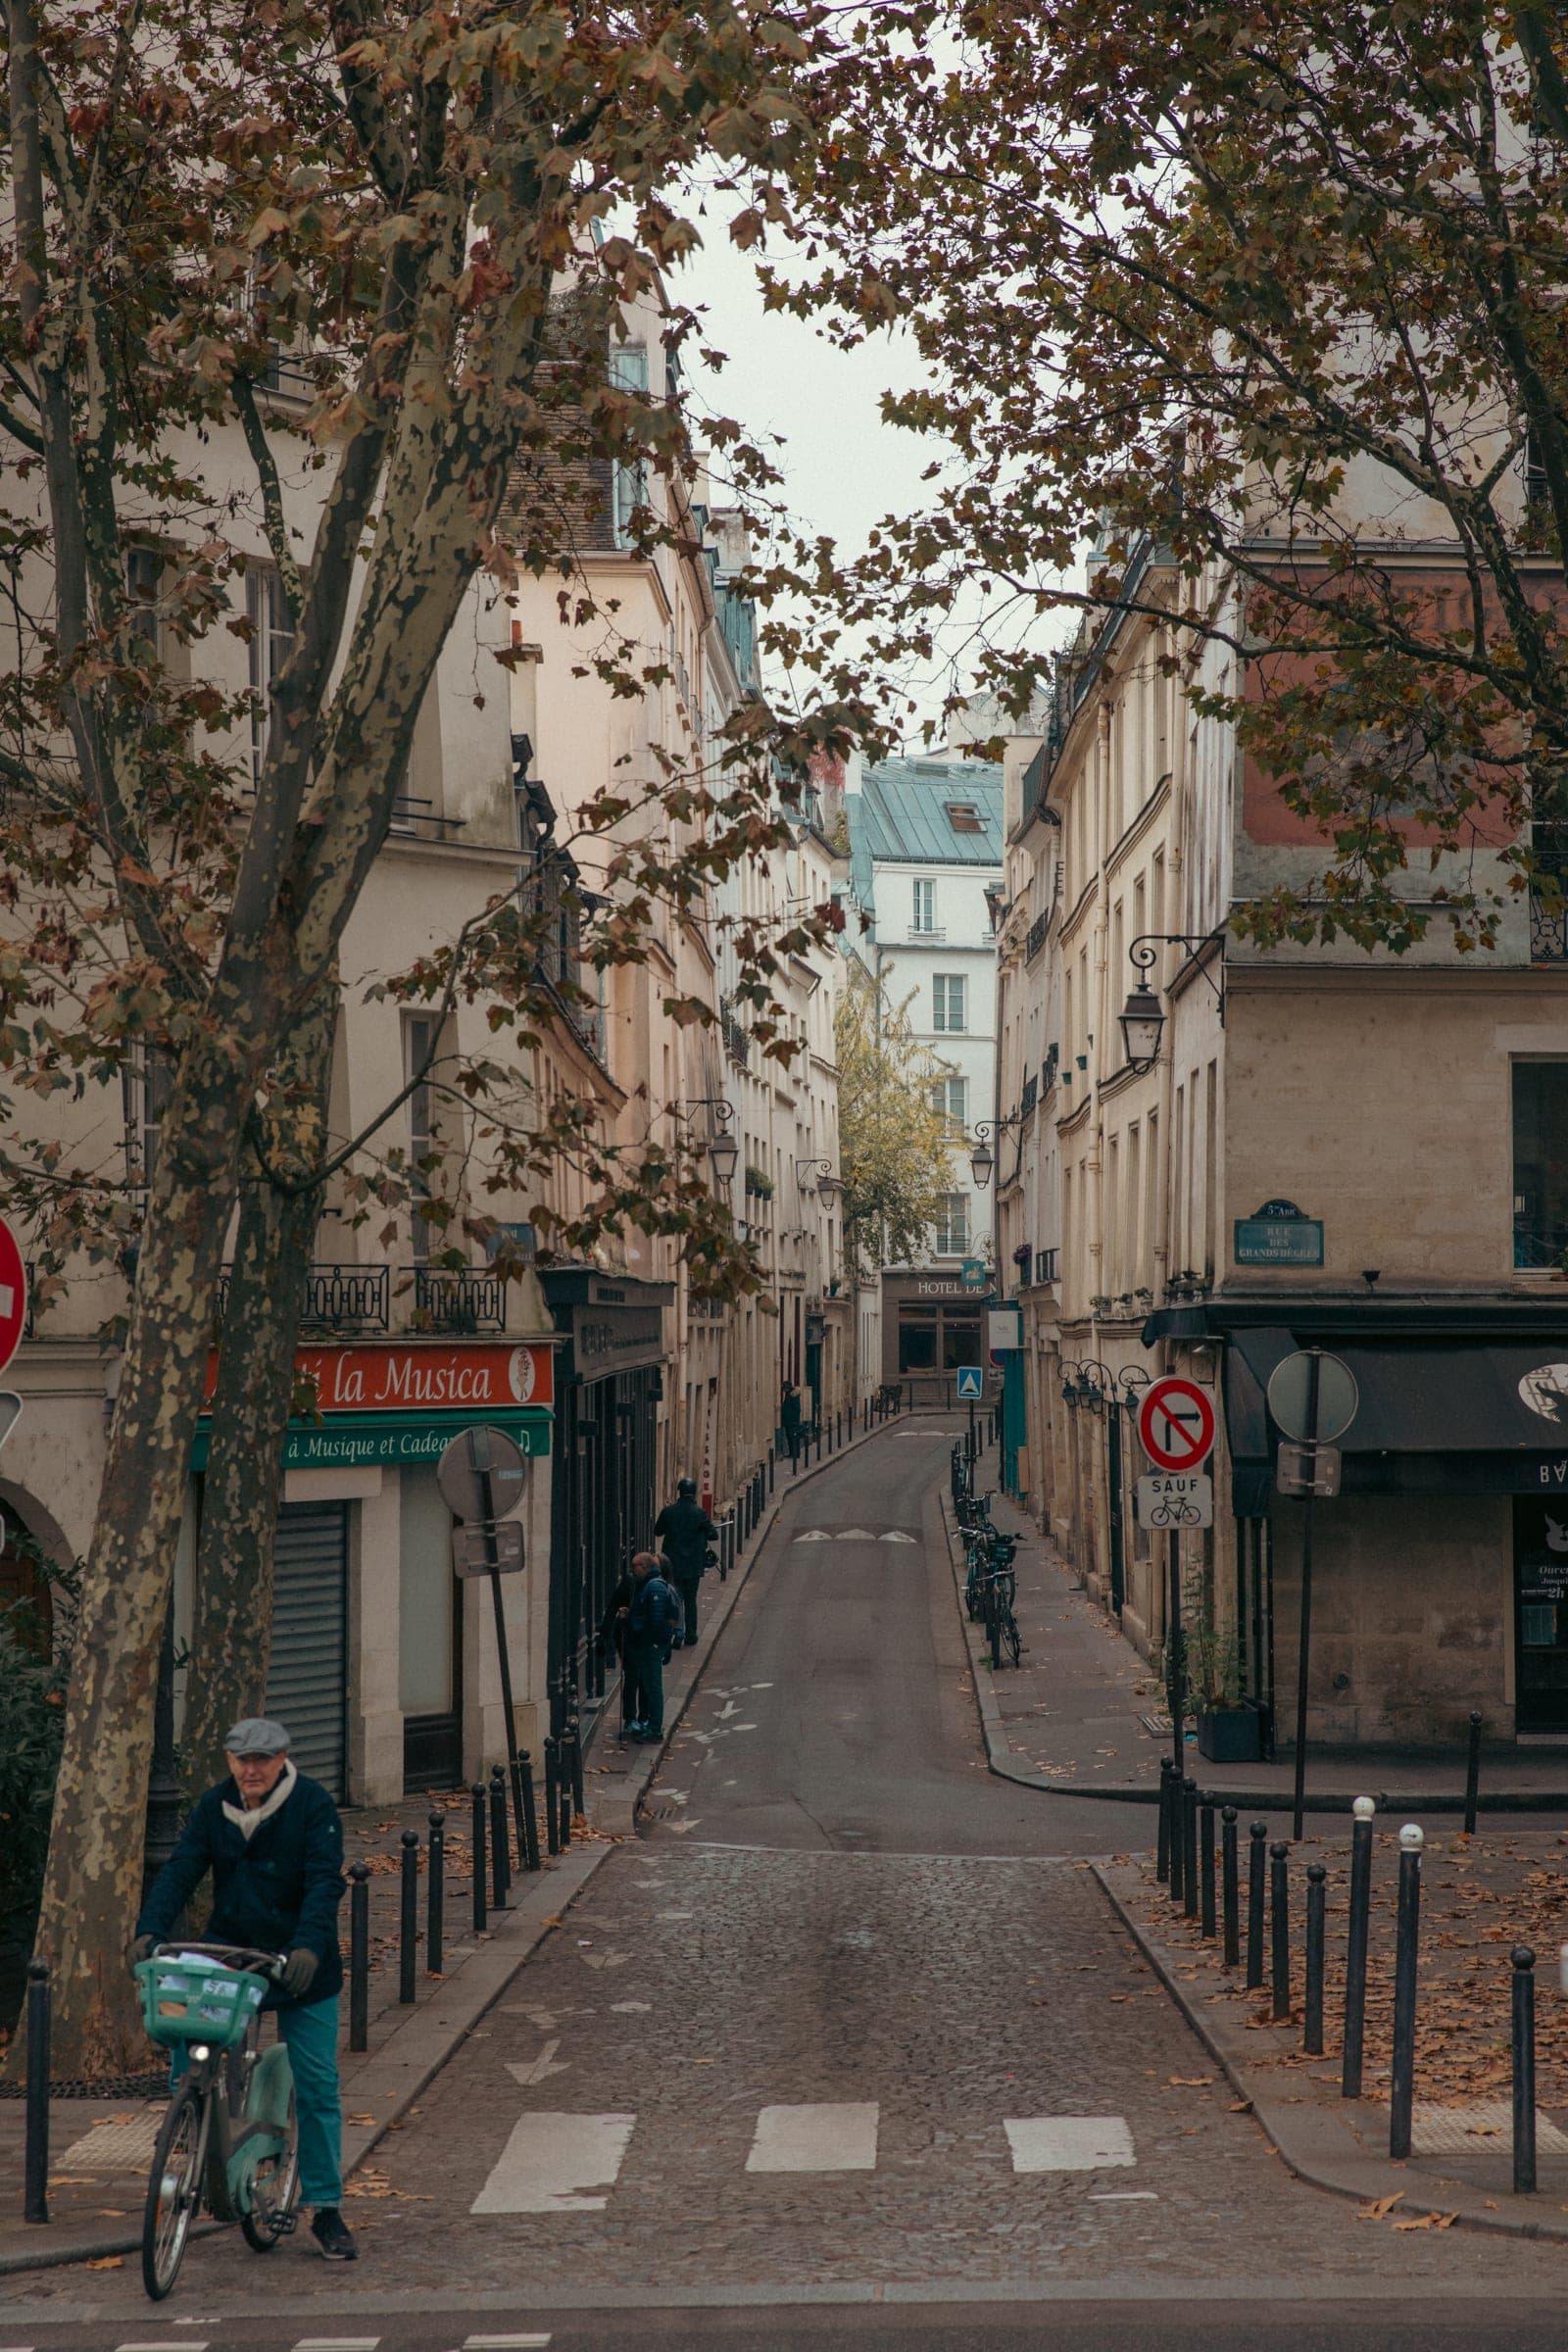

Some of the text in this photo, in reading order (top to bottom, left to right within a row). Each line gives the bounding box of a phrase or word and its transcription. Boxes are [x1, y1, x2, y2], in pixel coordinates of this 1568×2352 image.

[1266, 1227, 1291, 1236] RUE
[1239, 1249, 1277, 1257] GRANDS
[918, 1281, 960, 1295] HOTEL
[333, 1350, 366, 1403] la
[374, 1356, 492, 1401] Musica
[288, 1430, 456, 1462] à Musique et Cadea
[1152, 1479, 1198, 1493] SAUF
[1547, 1587, 1565, 1599] 2h
